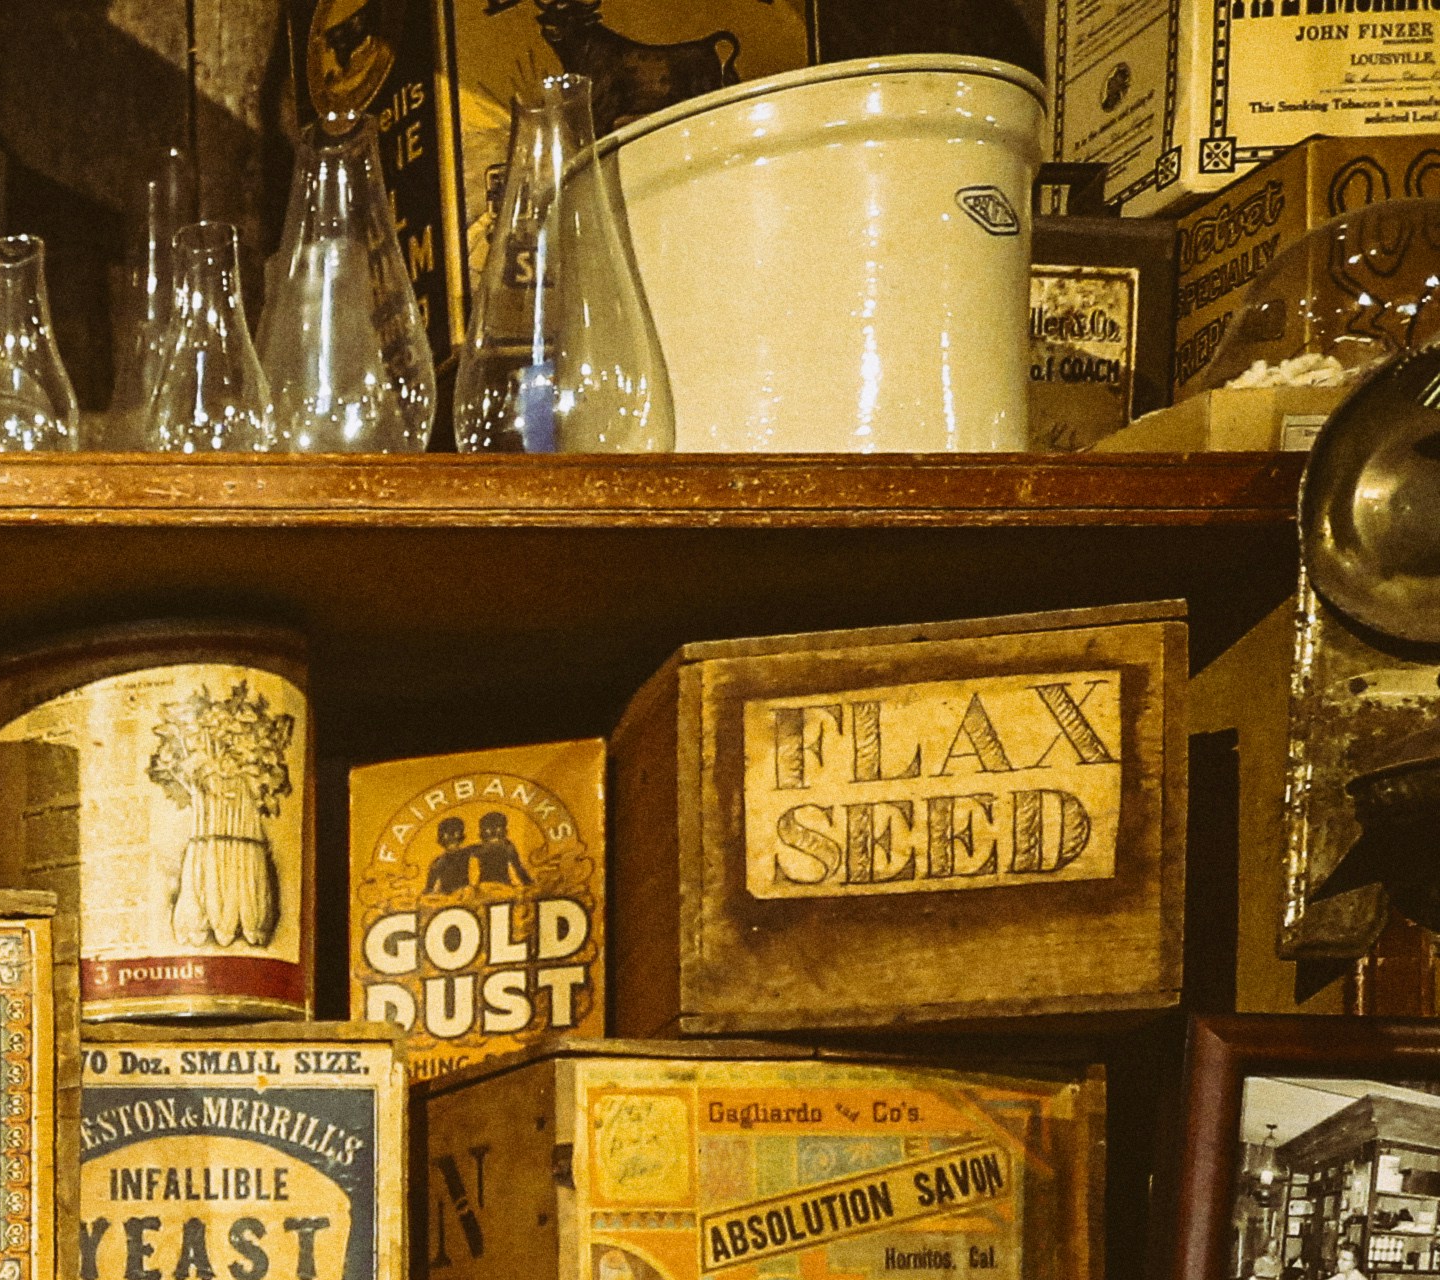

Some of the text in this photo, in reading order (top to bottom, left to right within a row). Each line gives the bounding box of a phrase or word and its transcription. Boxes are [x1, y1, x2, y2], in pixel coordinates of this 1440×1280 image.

[1296, 22, 1433, 41] JOHN FINZER
[772, 679, 1121, 791] FLAX
[773, 788, 1092, 888] SEED
[363, 898, 589, 975] GOLD
[118, 960, 205, 984] pounds
[364, 966, 585, 1039] DUST
[180, 1050, 370, 1076] SMALL SIZE.
[201, 1095, 364, 1163] MERRILL'S
[708, 1101, 822, 1130] Gagliardo
[109, 1167, 289, 1202] INFALLIBLE
[708, 1152, 1005, 1264] ABSOLUTION SAVON
